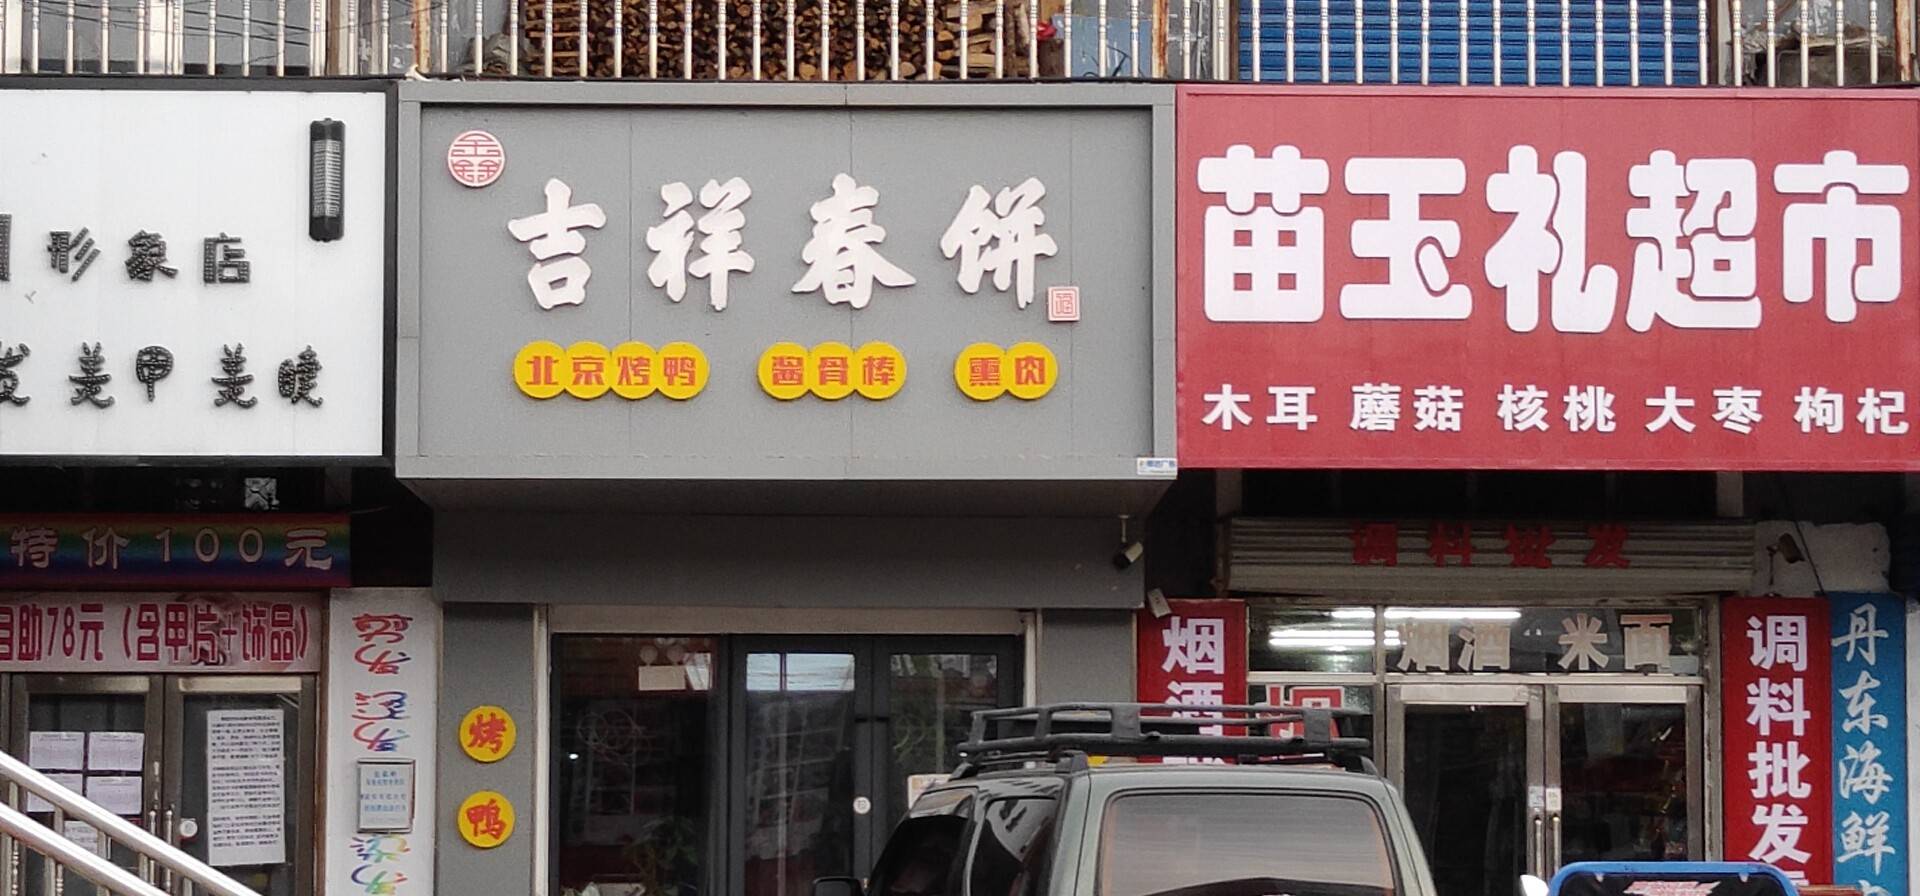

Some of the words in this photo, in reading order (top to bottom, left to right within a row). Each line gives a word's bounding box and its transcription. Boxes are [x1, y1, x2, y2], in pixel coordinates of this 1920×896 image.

[0, 215, 249, 284] 形象店
[508, 174, 1058, 310] 吉祥春饼
[1198, 145, 1909, 332] 苗玉礼超市
[526, 356, 696, 386] 北京烤鸭
[772, 356, 895, 386] 酱骨棒
[1203, 384, 1318, 431] 木耳
[1350, 383, 1464, 431] 蘑菇
[1498, 384, 1616, 432] 核桃
[1645, 387, 1763, 434] 大枣
[1794, 387, 1909, 434] 枸杞
[10, 527, 333, 570] 特价100元
[1397, 618, 1511, 671] 烟酒
[1558, 612, 1673, 671] 米面
[1162, 616, 1225, 764] 烟酒
[1746, 615, 1812, 885] 调料批发
